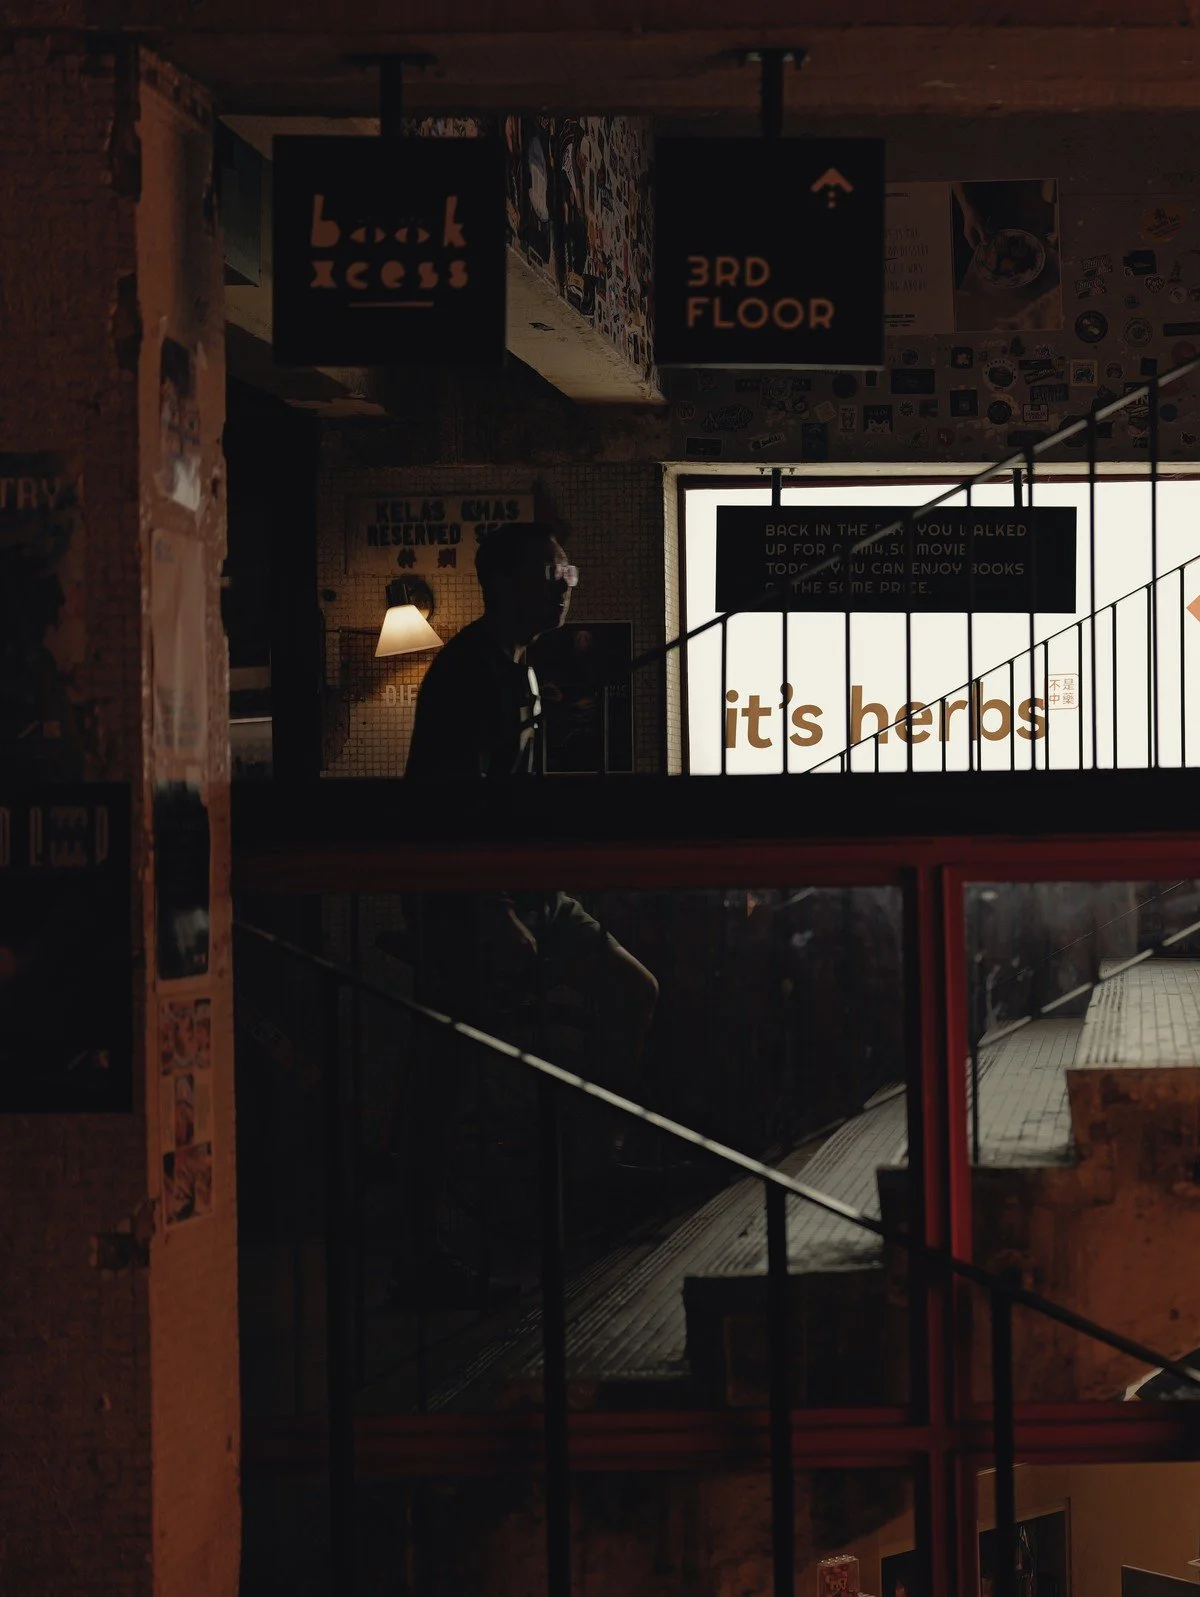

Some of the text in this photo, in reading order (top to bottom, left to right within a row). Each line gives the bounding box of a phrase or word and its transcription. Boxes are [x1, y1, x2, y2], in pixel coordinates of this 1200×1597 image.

[310, 260, 469, 289] xcess
[686, 255, 771, 288] 3RD
[686, 297, 836, 330] FLOOR
[375, 500, 446, 522] KELAS
[366, 523, 462, 546] RESERVED
[765, 523, 810, 537] BACK
[815, 523, 831, 537] IN
[837, 523, 868, 537] THE
[917, 523, 952, 537] YOU
[765, 543, 787, 556] UP
[793, 543, 825, 556] FOR
[871, 562, 905, 575] CAN
[911, 562, 962, 575] ENJOY
[792, 581, 822, 594] THE
[725, 680, 1050, 749] it's herbs
